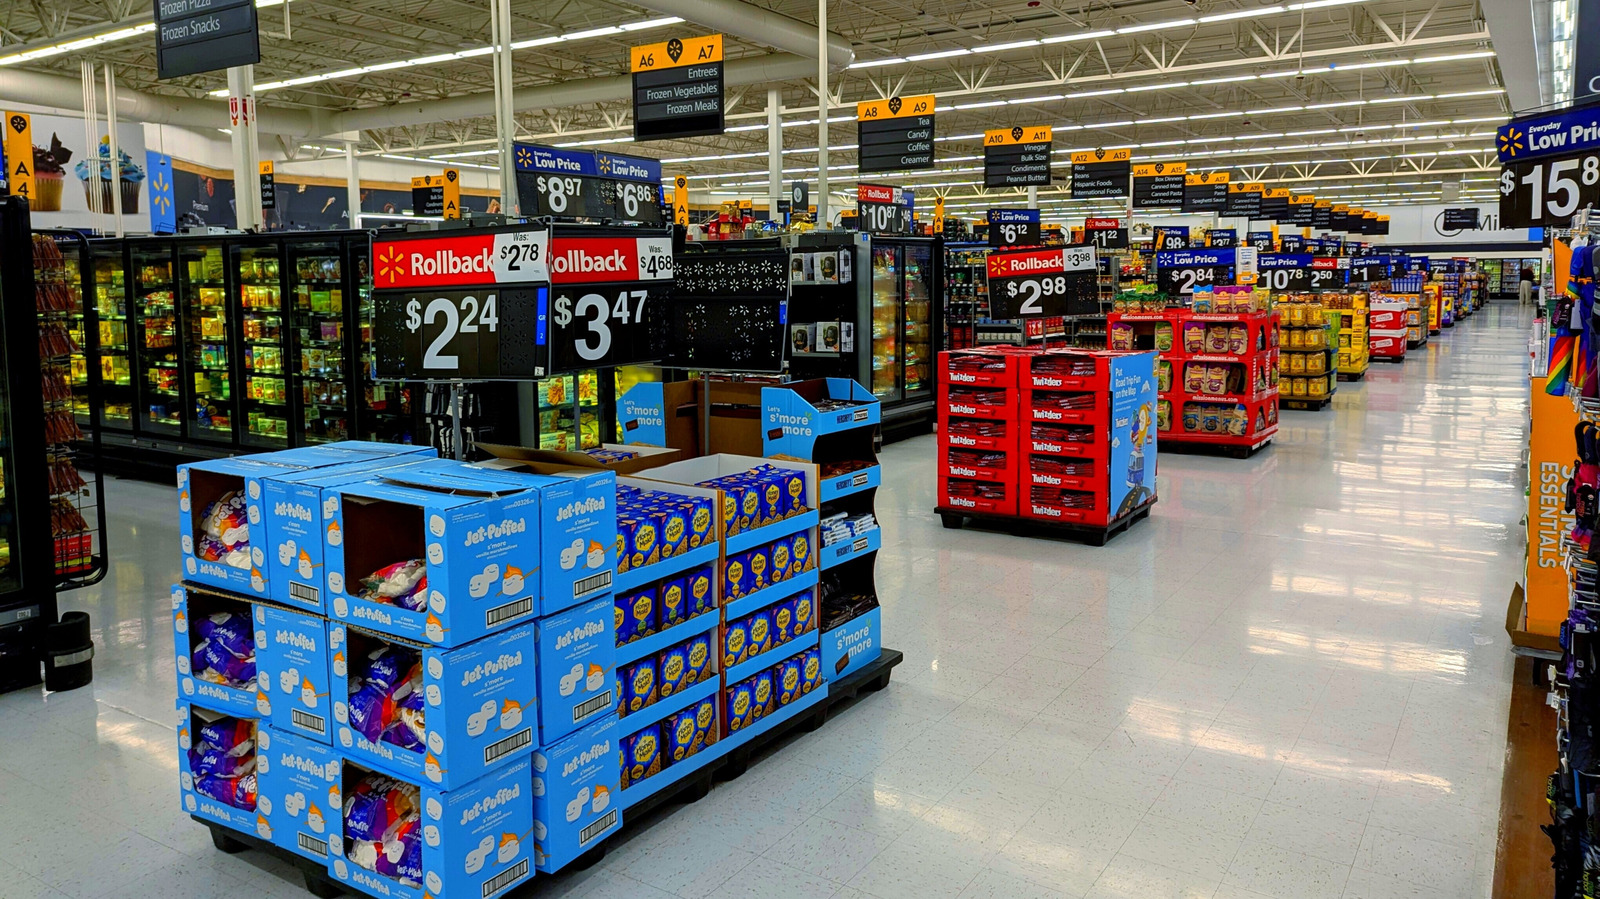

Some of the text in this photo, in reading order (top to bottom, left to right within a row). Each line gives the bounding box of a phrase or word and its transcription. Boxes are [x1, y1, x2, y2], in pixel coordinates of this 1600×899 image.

[160, 0, 212, 16] Frozen Pizza
[162, 16, 221, 42] Frozen Snacks
[639, 45, 714, 68] A6 A7
[688, 68, 718, 79] Entrees
[646, 83, 717, 100] Frozen Vegetables
[667, 99, 718, 114] Frozen Meals
[864, 102, 927, 118] A8 A9
[918, 118, 930, 126] Tea
[1528, 122, 1561, 133] Everyday
[907, 130, 929, 140] Candy
[988, 131, 1046, 144] A10 A11
[1528, 121, 1600, 152] Low Pri
[907, 143, 930, 152] Coffee
[1023, 144, 1047, 152] Vinegar
[533, 150, 552, 159] Everyday
[1075, 151, 1127, 162] A12 A13
[534, 156, 581, 171] Low Price
[901, 156, 930, 165] Creamer
[612, 164, 649, 178] Low Price
[1011, 164, 1047, 172] Condiments
[1006, 174, 1046, 183] Peanut Butter
[867, 189, 890, 200] Rollback
[1074, 188, 1106, 196] International
[512, 232, 529, 242] Was:
[648, 245, 663, 254] Was:
[411, 247, 494, 276] Rollback
[1010, 255, 1064, 271] Rollback
[1174, 254, 1218, 265] Low Price
[1278, 258, 1298, 266] Price
[949, 372, 976, 382] Twizzlers
[1115, 367, 1123, 377] Put
[1032, 376, 1062, 387] Twizzlers
[1115, 377, 1126, 388] Road
[1133, 375, 1141, 384] Fun
[1128, 386, 1137, 397] Map
[626, 404, 660, 417] s'more
[767, 405, 781, 413] Let's
[949, 404, 976, 414] Twizzlers
[1032, 409, 1062, 420] Twizzlers
[637, 416, 663, 427] more
[769, 412, 809, 426] s'more
[782, 425, 812, 437] more
[949, 435, 976, 445] Twizzlers
[1032, 441, 1061, 452] Twizzlers
[693, 512, 708, 525] Honey
[1538, 462, 1560, 568] ESSENTIALS
[666, 521, 683, 534] Honey
[636, 530, 654, 543] Honey
[837, 625, 870, 651] s'more
[848, 636, 872, 658] more
